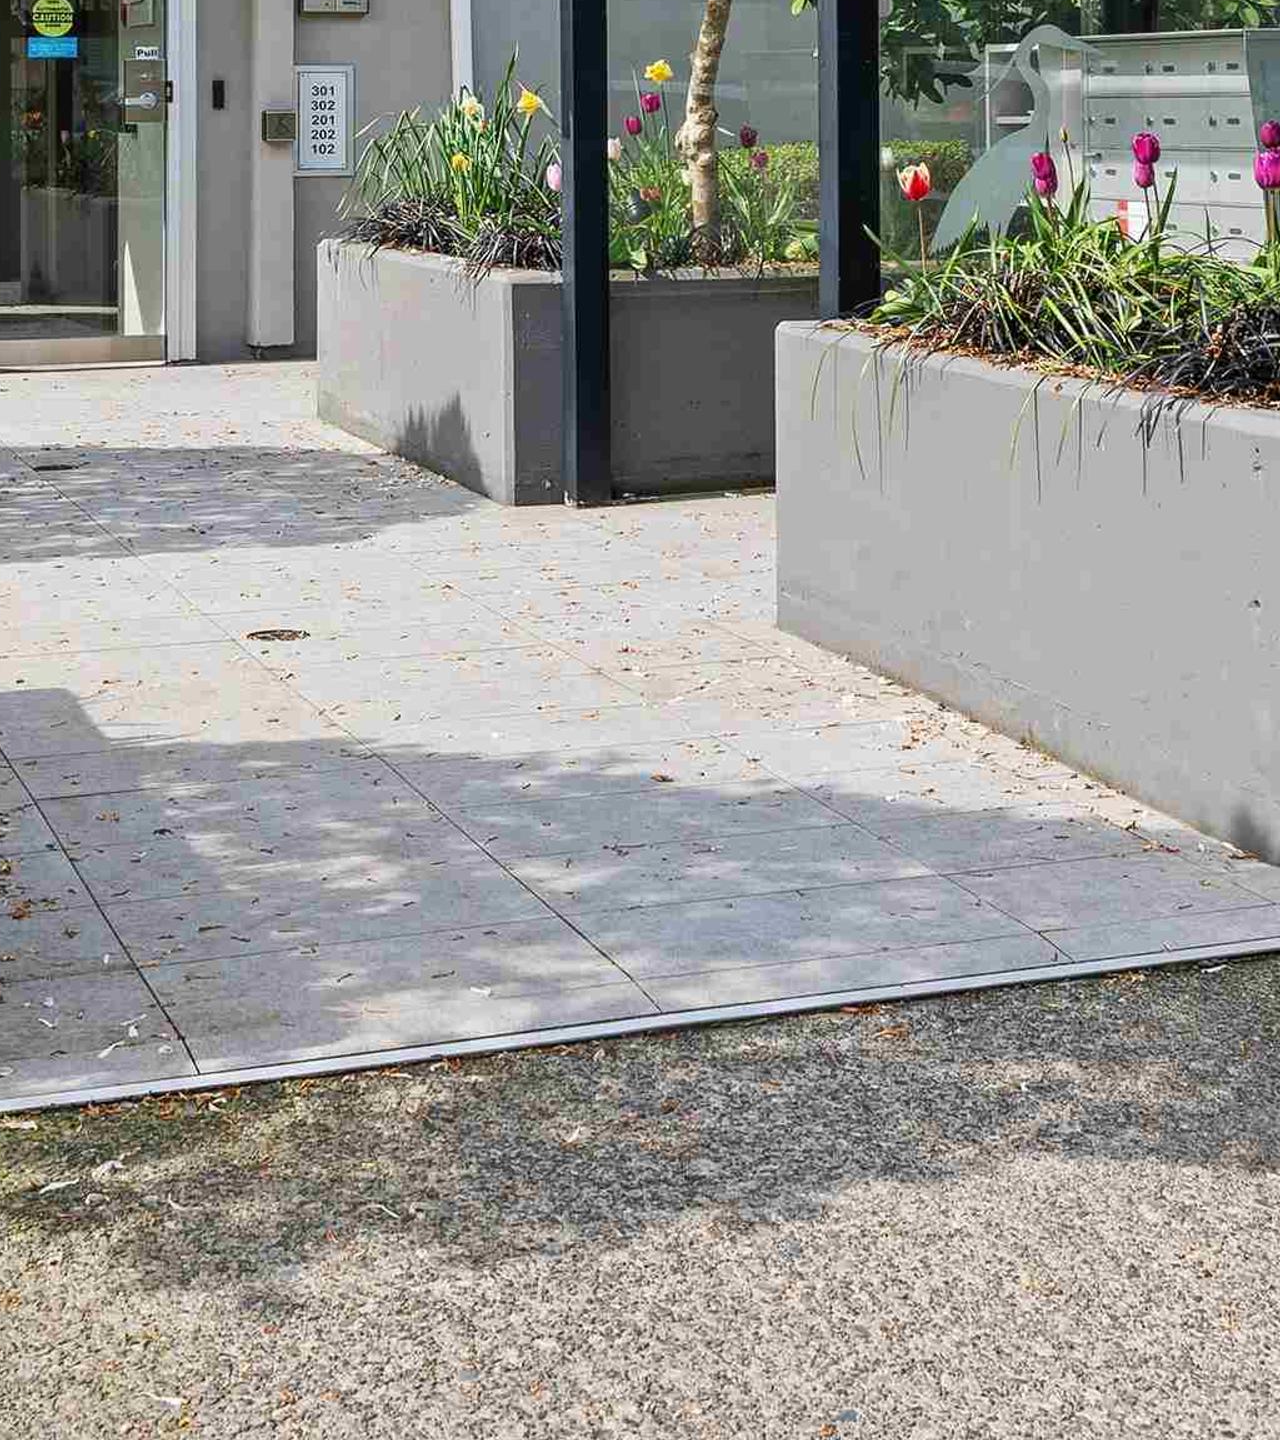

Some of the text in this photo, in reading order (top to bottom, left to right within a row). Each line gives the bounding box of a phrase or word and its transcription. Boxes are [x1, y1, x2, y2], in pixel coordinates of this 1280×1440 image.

[32, 12, 73, 23] CAUTION
[136, 48, 158, 58] Pull
[311, 85, 335, 97] 301
[311, 100, 336, 111] 302
[311, 114, 335, 125] 201
[311, 129, 336, 140] 202
[311, 143, 336, 154] 102
